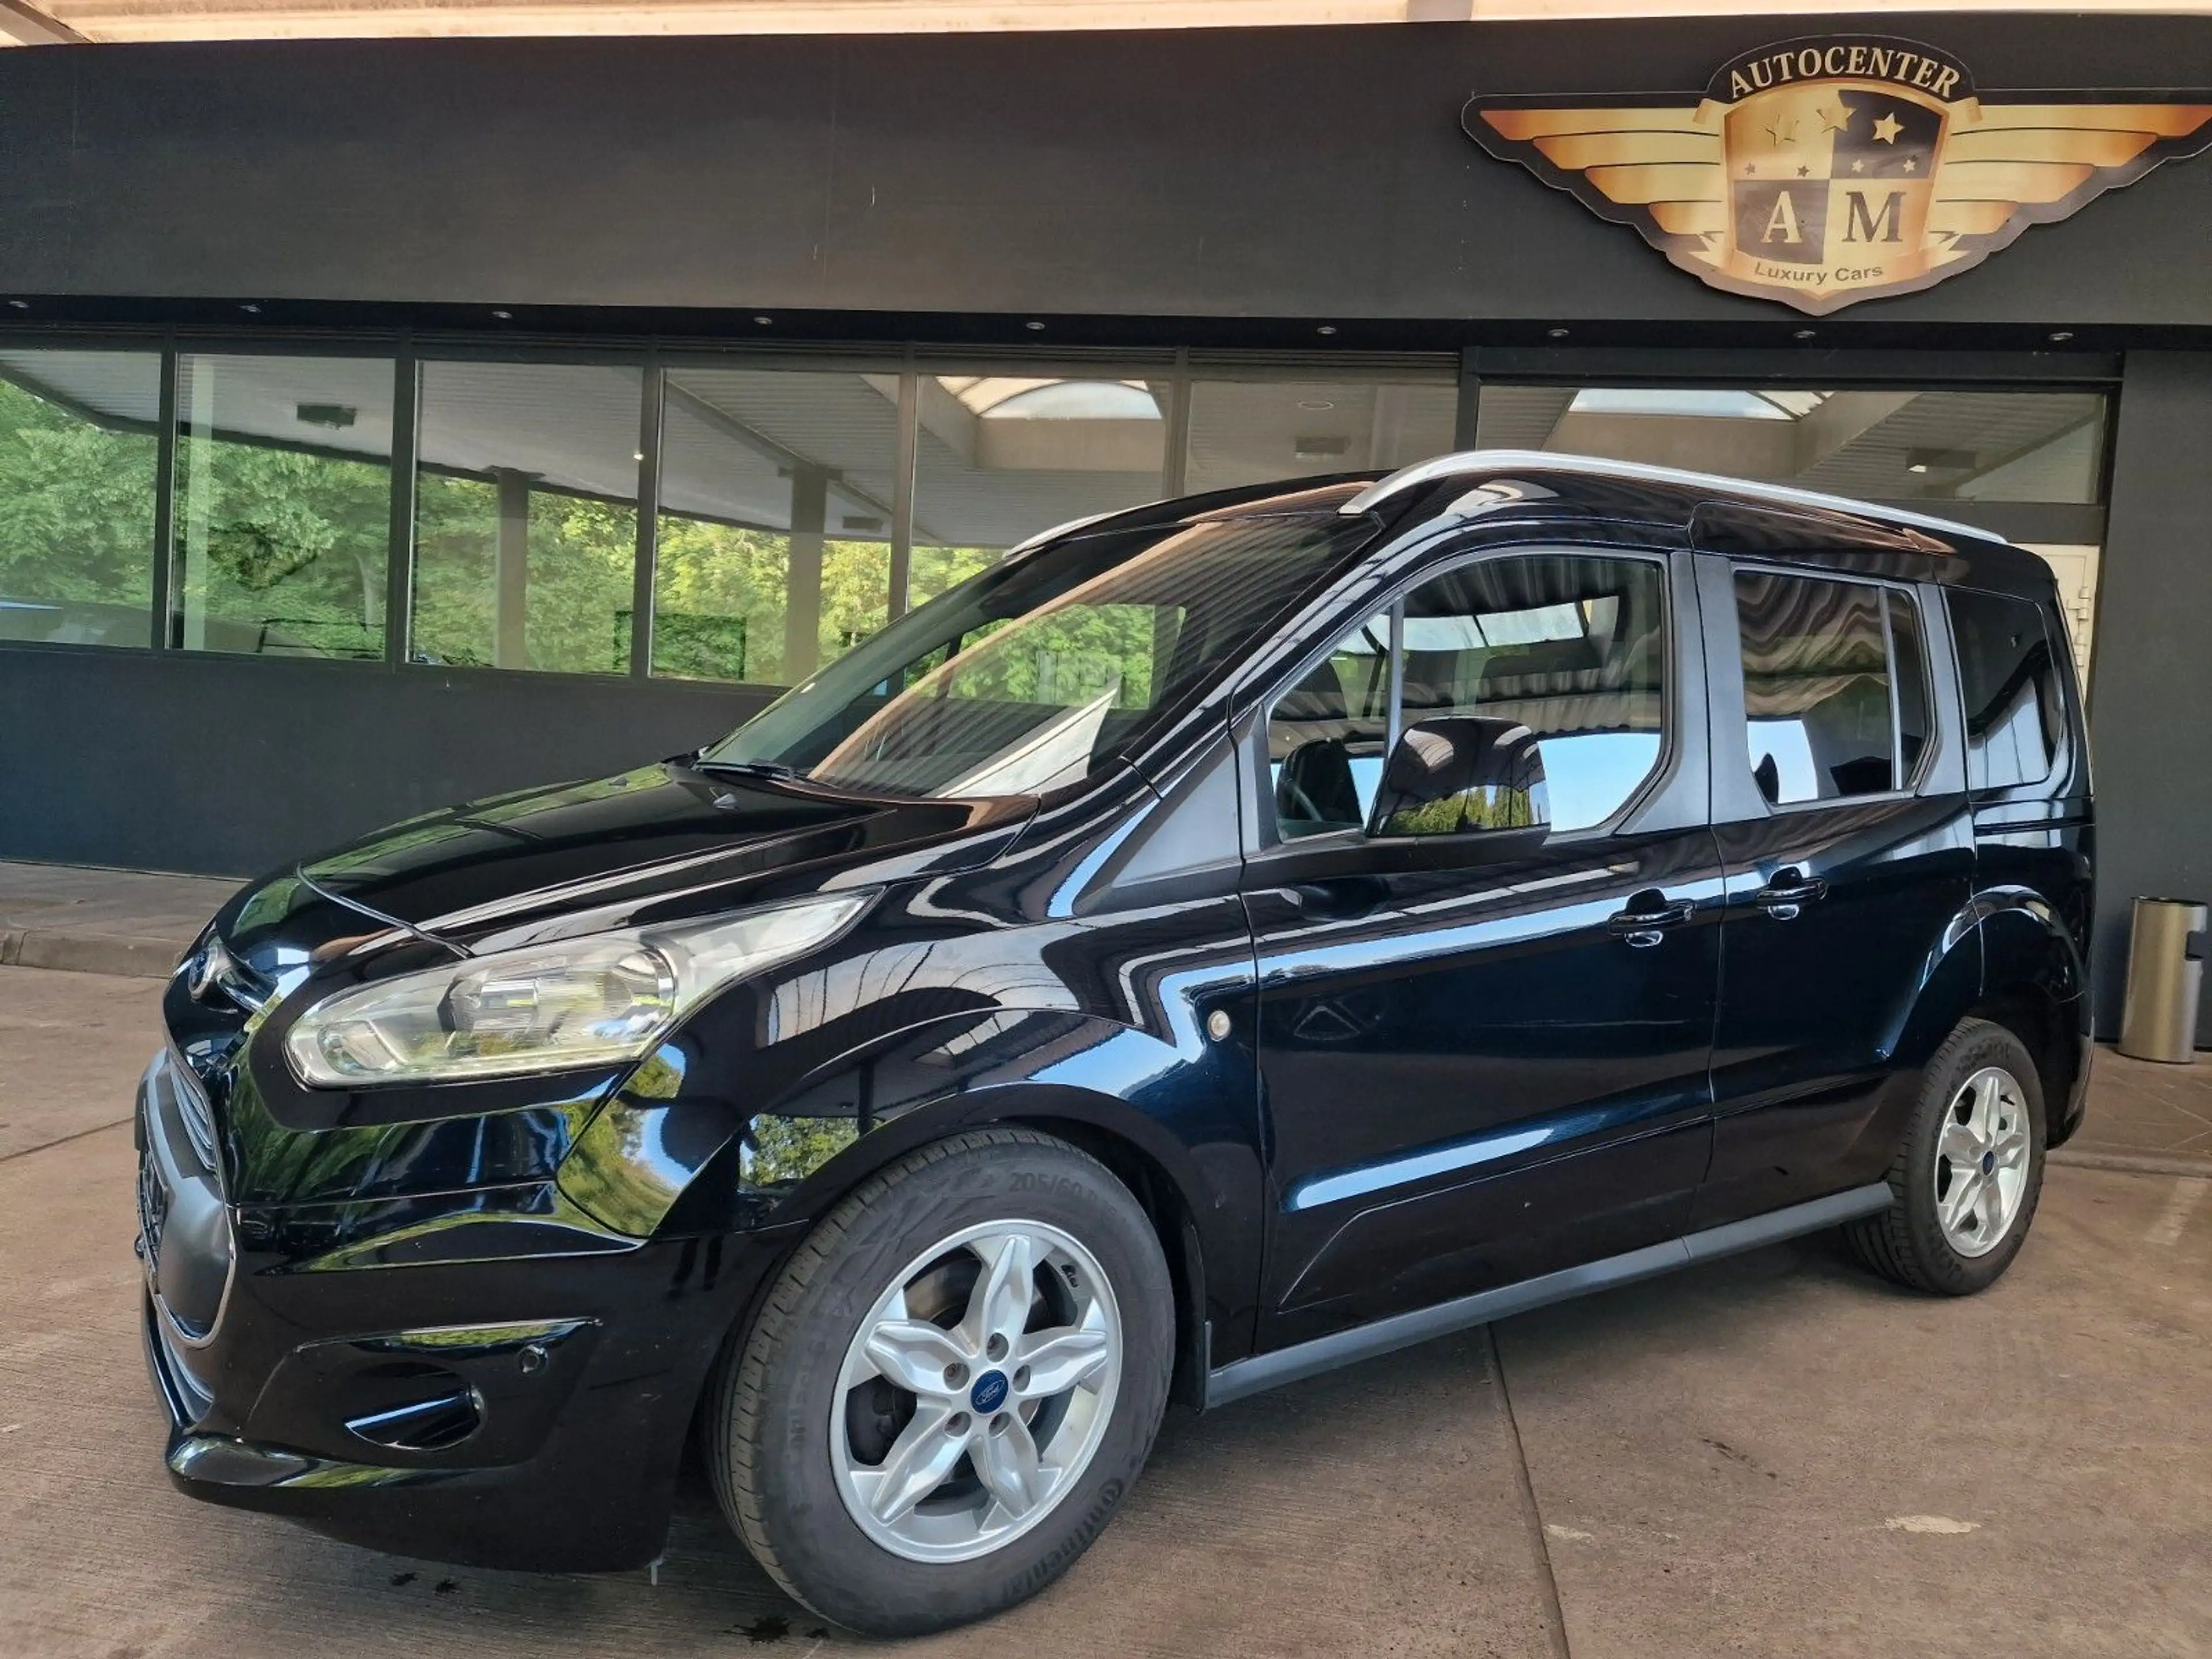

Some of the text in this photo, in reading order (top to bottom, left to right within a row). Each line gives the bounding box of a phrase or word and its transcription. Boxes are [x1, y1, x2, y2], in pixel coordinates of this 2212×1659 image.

[1730, 47, 1960, 99] AUTOCENTER
[1760, 191, 1906, 243] A M
[1755, 262, 1884, 286] Luxury Cars
